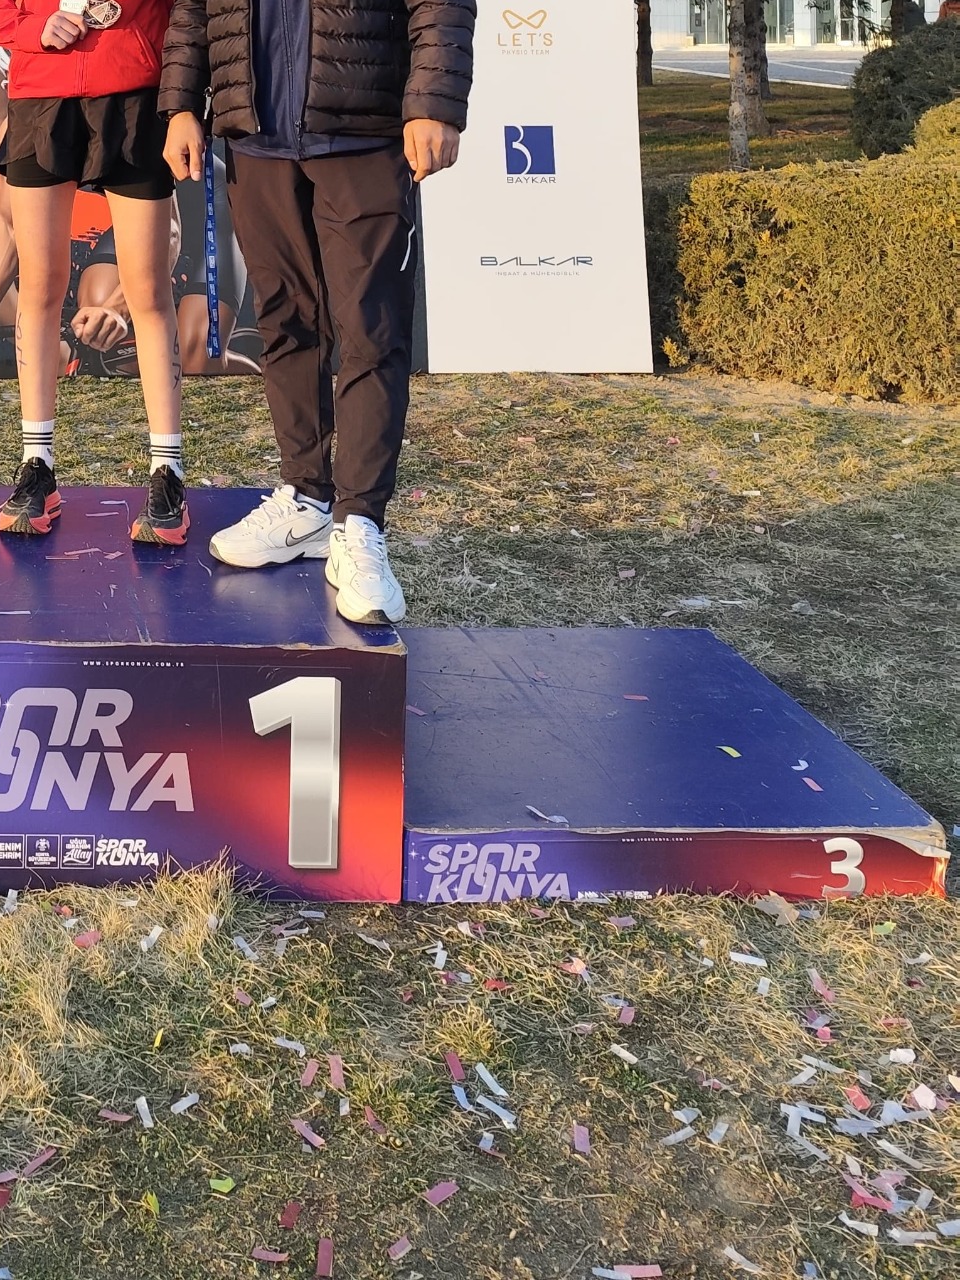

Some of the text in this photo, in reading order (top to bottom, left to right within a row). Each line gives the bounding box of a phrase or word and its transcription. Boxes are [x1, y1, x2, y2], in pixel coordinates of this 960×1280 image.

[497, 32, 553, 47] LET'S
[506, 176, 557, 184] BAYKAR
[480, 256, 593, 266] BALKAR
[248, 676, 341, 869] 1
[424, 843, 541, 874] SPOR
[822, 837, 866, 897] 3
[427, 867, 571, 902] KONYA
